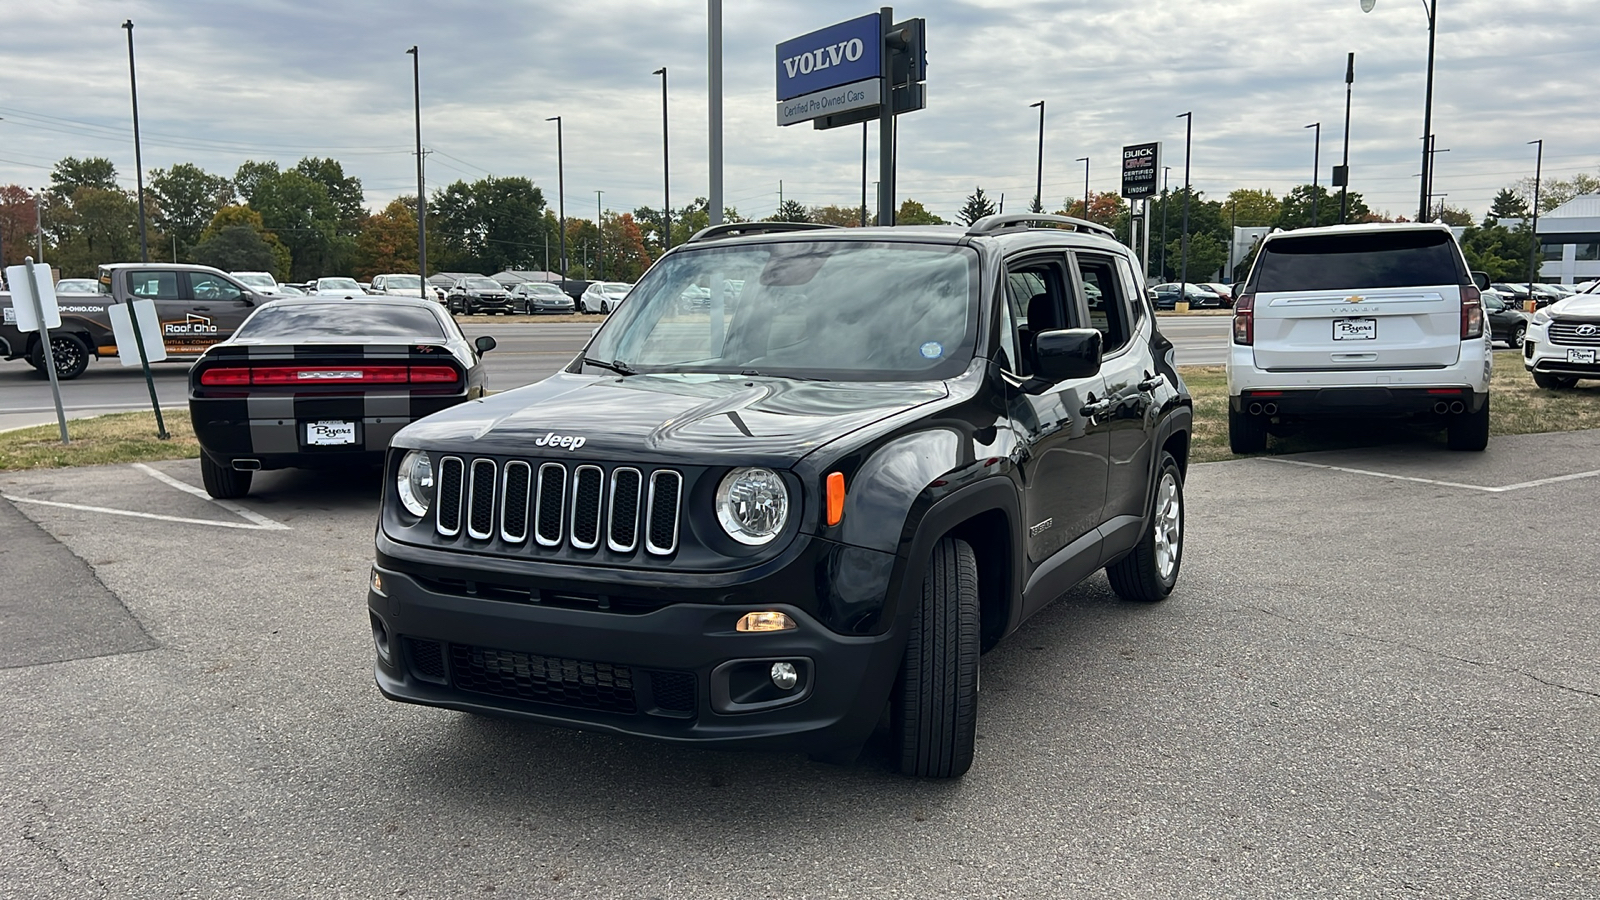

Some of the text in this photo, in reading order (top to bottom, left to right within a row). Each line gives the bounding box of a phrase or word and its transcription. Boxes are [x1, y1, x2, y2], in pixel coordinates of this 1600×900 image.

[783, 38, 864, 79] VOLVO
[784, 90, 865, 118] Certified Pre Owned Cars
[1124, 148, 1153, 158] BUICK
[1125, 157, 1152, 169] GMC
[1123, 168, 1154, 177] CERTIFIED
[1127, 186, 1148, 194] LINDSAY
[165, 323, 191, 333] Roof
[311, 425, 351, 438] Byers
[535, 432, 586, 451] Jeep
